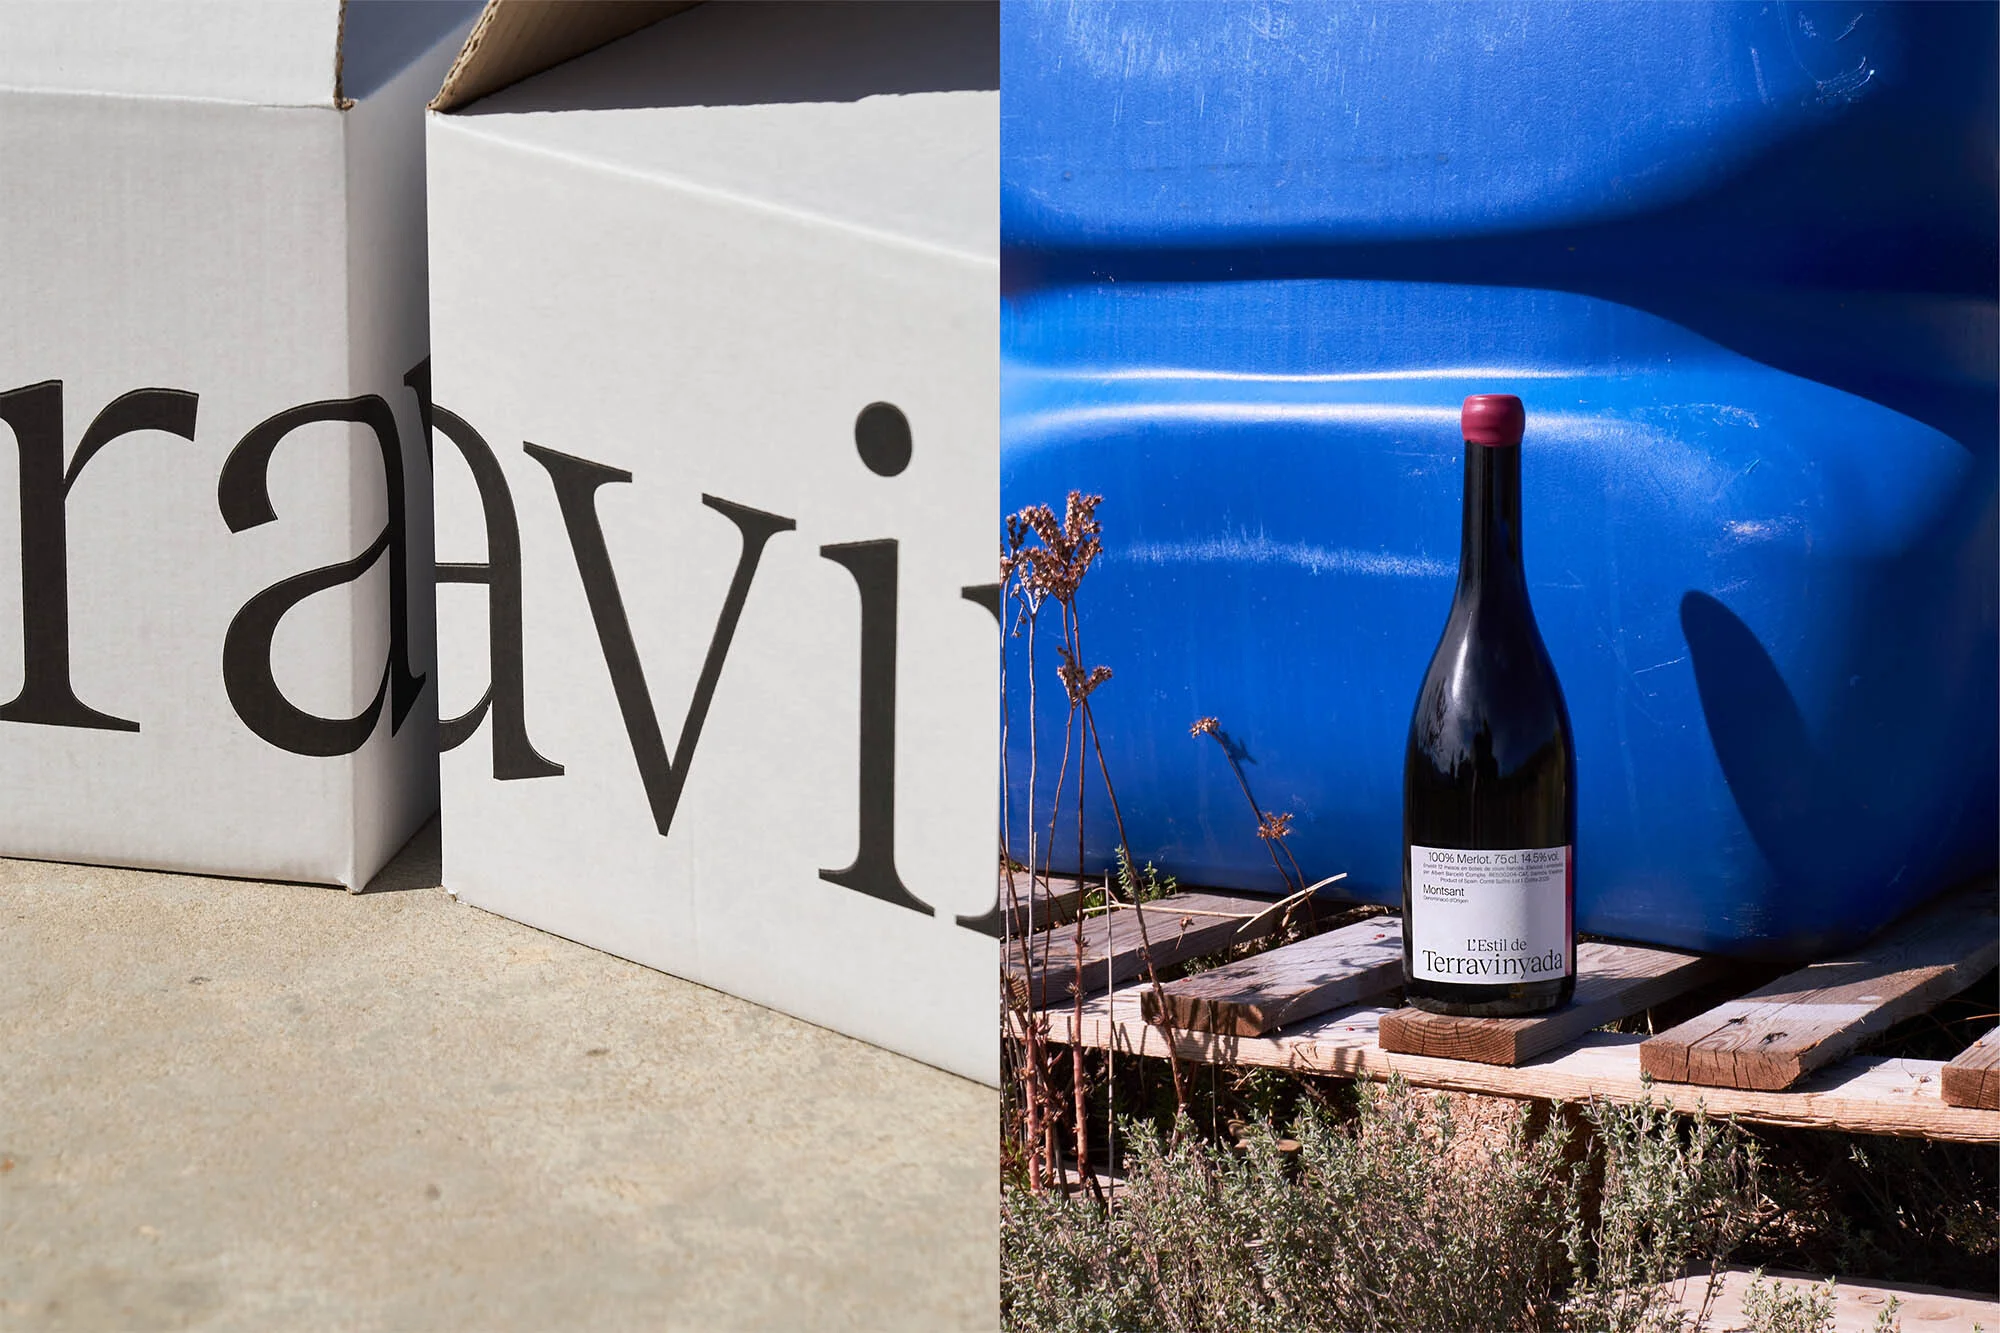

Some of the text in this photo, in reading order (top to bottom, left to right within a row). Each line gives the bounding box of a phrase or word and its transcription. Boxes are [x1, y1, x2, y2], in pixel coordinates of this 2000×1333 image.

[1429, 851, 1454, 863] 100%
[1457, 854, 1491, 865] Merlot.
[1423, 883, 1464, 896] Montsant
[1510, 938, 1528, 951] de
[1422, 949, 1563, 979] Terravinyada
